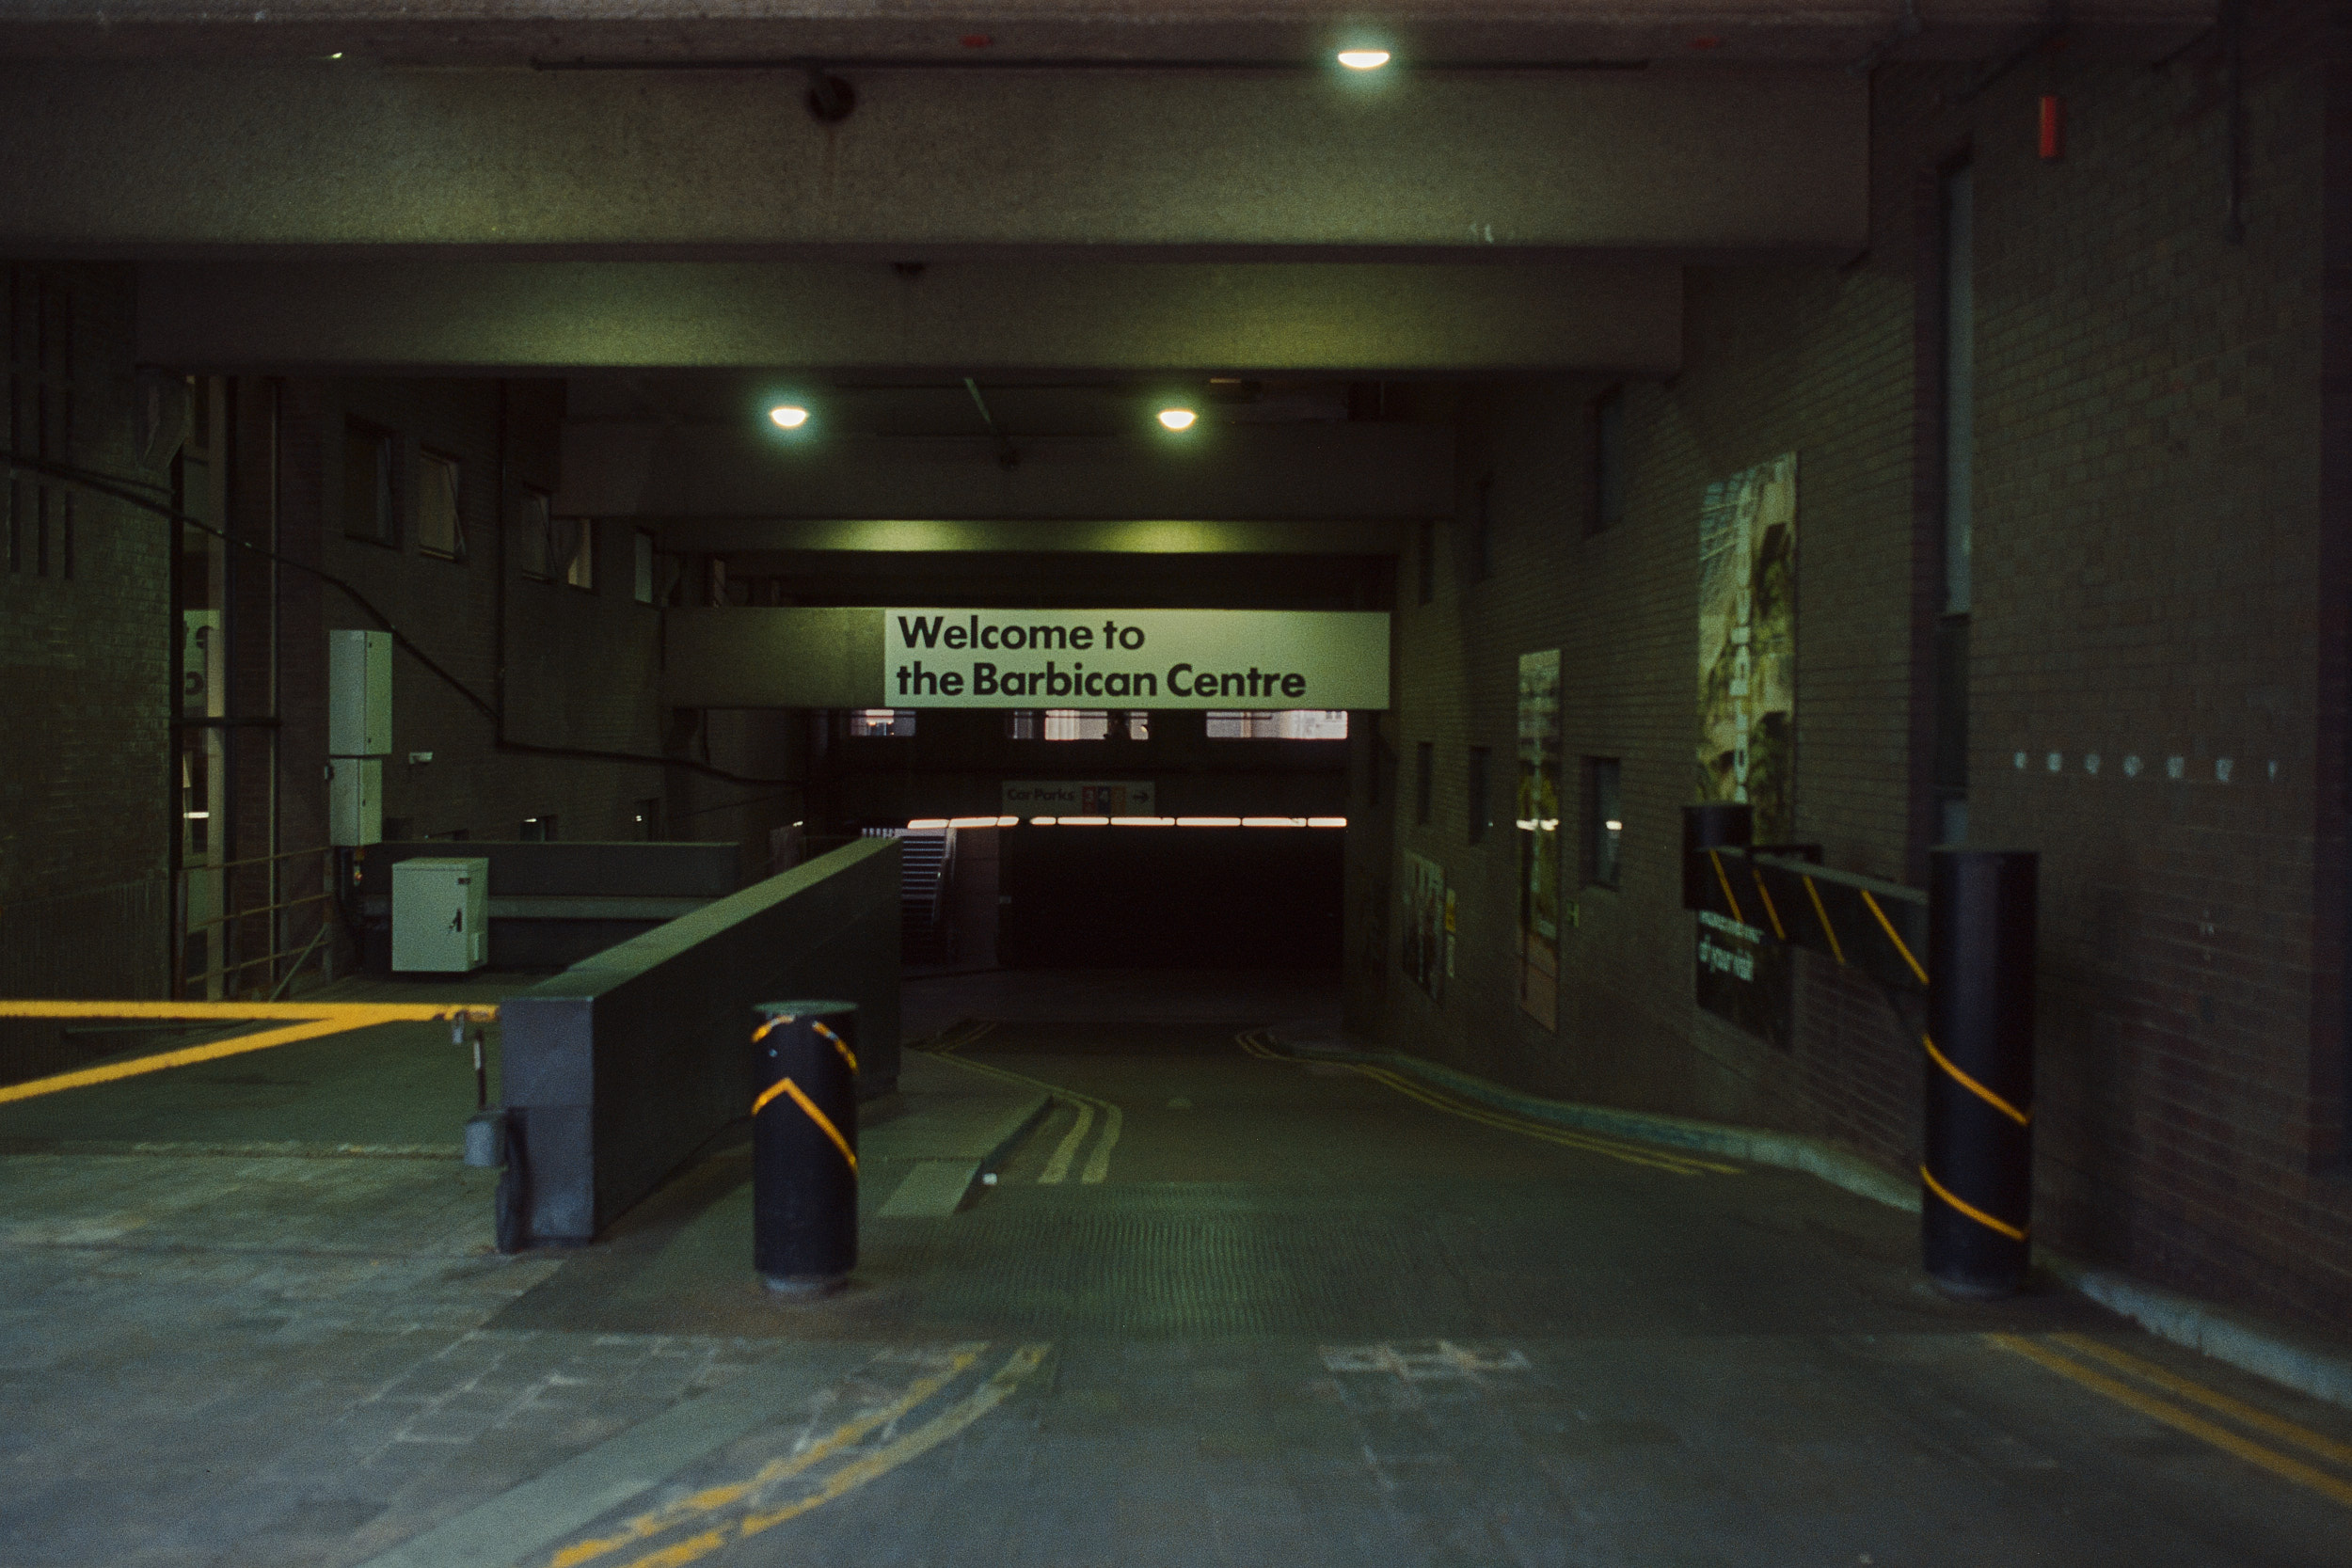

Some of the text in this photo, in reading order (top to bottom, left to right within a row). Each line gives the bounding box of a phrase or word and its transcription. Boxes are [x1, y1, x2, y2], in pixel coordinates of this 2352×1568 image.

[898, 614, 1146, 650] Welcome to
[896, 661, 1307, 698] the Barbican Centre
[1008, 788, 1032, 800] Car
[1034, 787, 1075, 800] Parks
